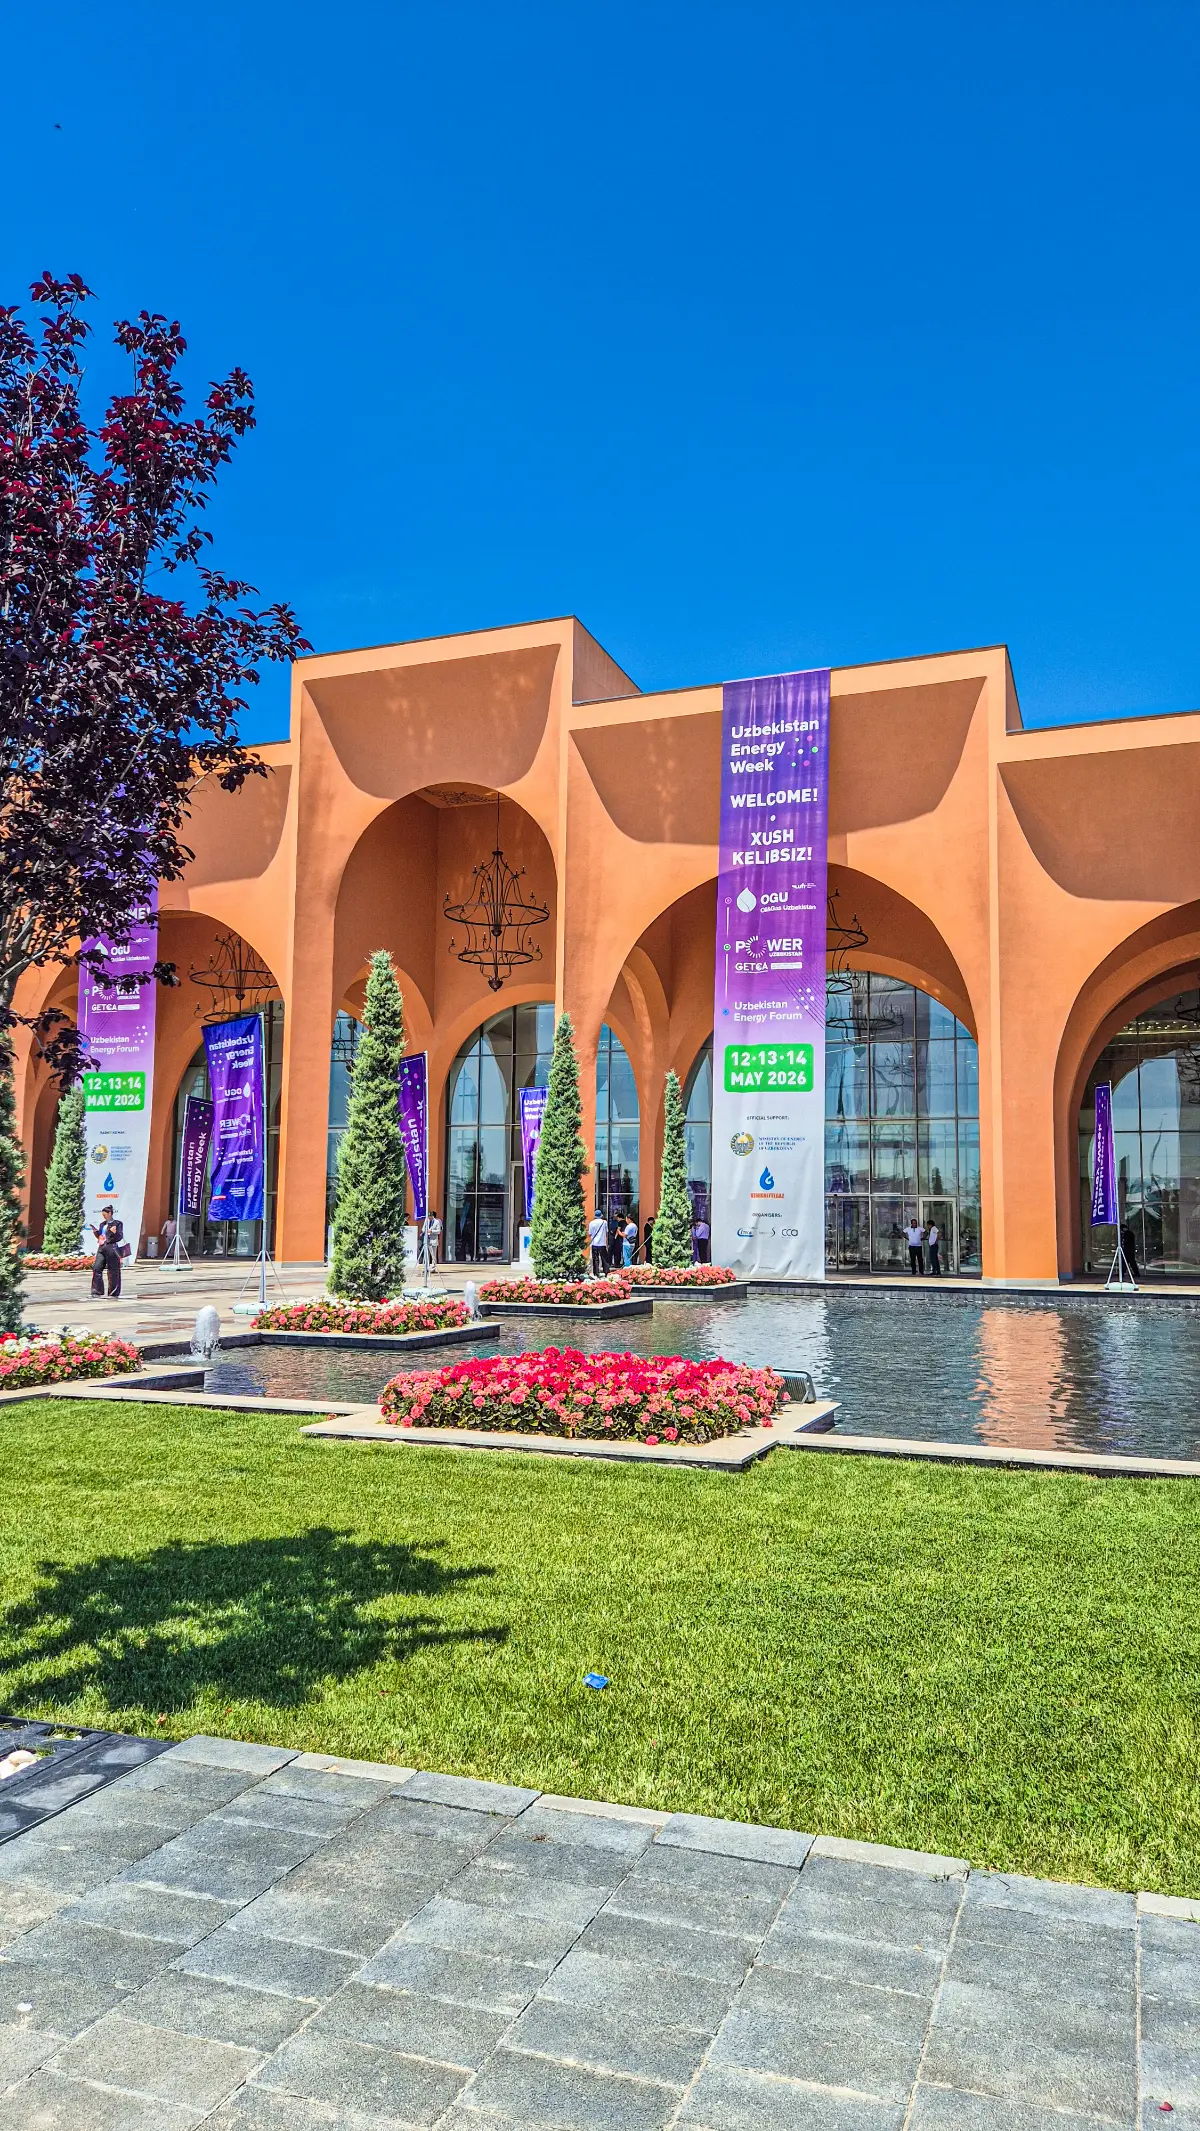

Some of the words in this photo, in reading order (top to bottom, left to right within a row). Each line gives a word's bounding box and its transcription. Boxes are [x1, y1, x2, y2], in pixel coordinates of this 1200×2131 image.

[731, 719, 819, 738] Uzbekistan
[730, 740, 785, 756] Energy
[730, 758, 774, 774] Week
[730, 788, 818, 808] WELCOME!
[750, 828, 794, 846] XUSH
[732, 846, 812, 865] KELIBSIZ!
[760, 891, 788, 905] OGU
[110, 945, 130, 956] OGU
[92, 983, 140, 1000] POWR
[734, 1000, 787, 1011] Uzbekistan
[734, 1012, 766, 1023] Energy
[769, 1011, 802, 1021] Forum
[90, 1036, 129, 1044] Uzbekistan
[90, 1045, 115, 1055] Energy
[117, 1045, 140, 1053] Forum
[731, 1072, 764, 1086] MAY
[767, 1071, 807, 1086] 2026
[87, 1095, 112, 1107] MAY
[114, 1094, 141, 1106] 2026
[194, 1132, 207, 1165] Week
[191, 1167, 202, 1210] Energy
